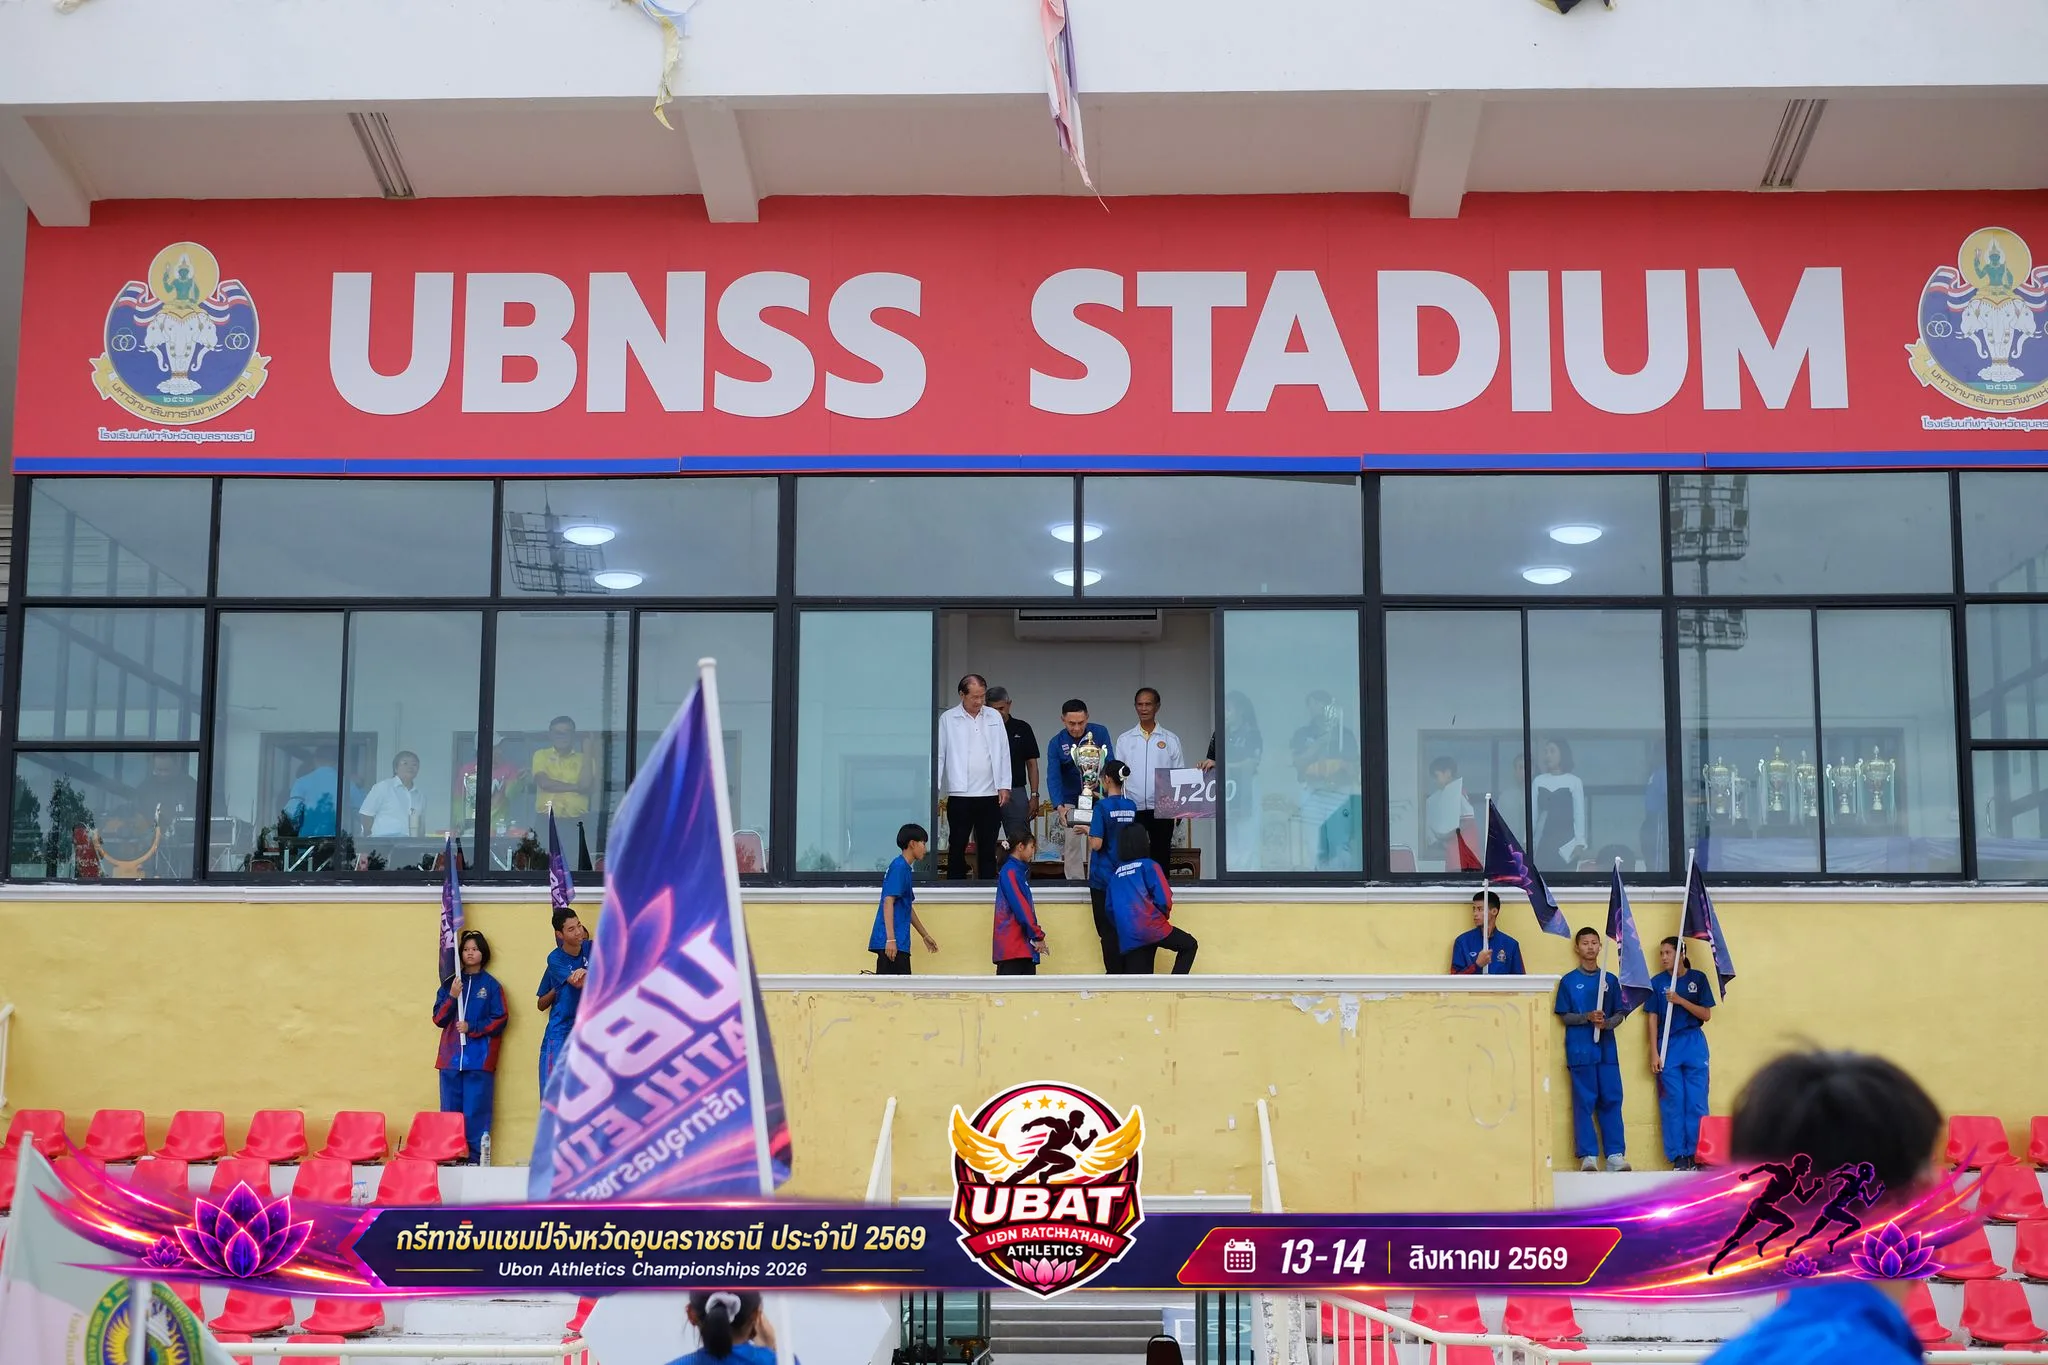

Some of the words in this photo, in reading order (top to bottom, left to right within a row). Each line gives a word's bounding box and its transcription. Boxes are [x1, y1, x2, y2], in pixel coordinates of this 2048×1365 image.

[330, 271, 926, 418] UBNSS
[1030, 267, 1848, 415] STADIUM
[99, 428, 253, 442] โรงเรียนกีฬาจังหวัดอุบลราชธานี
